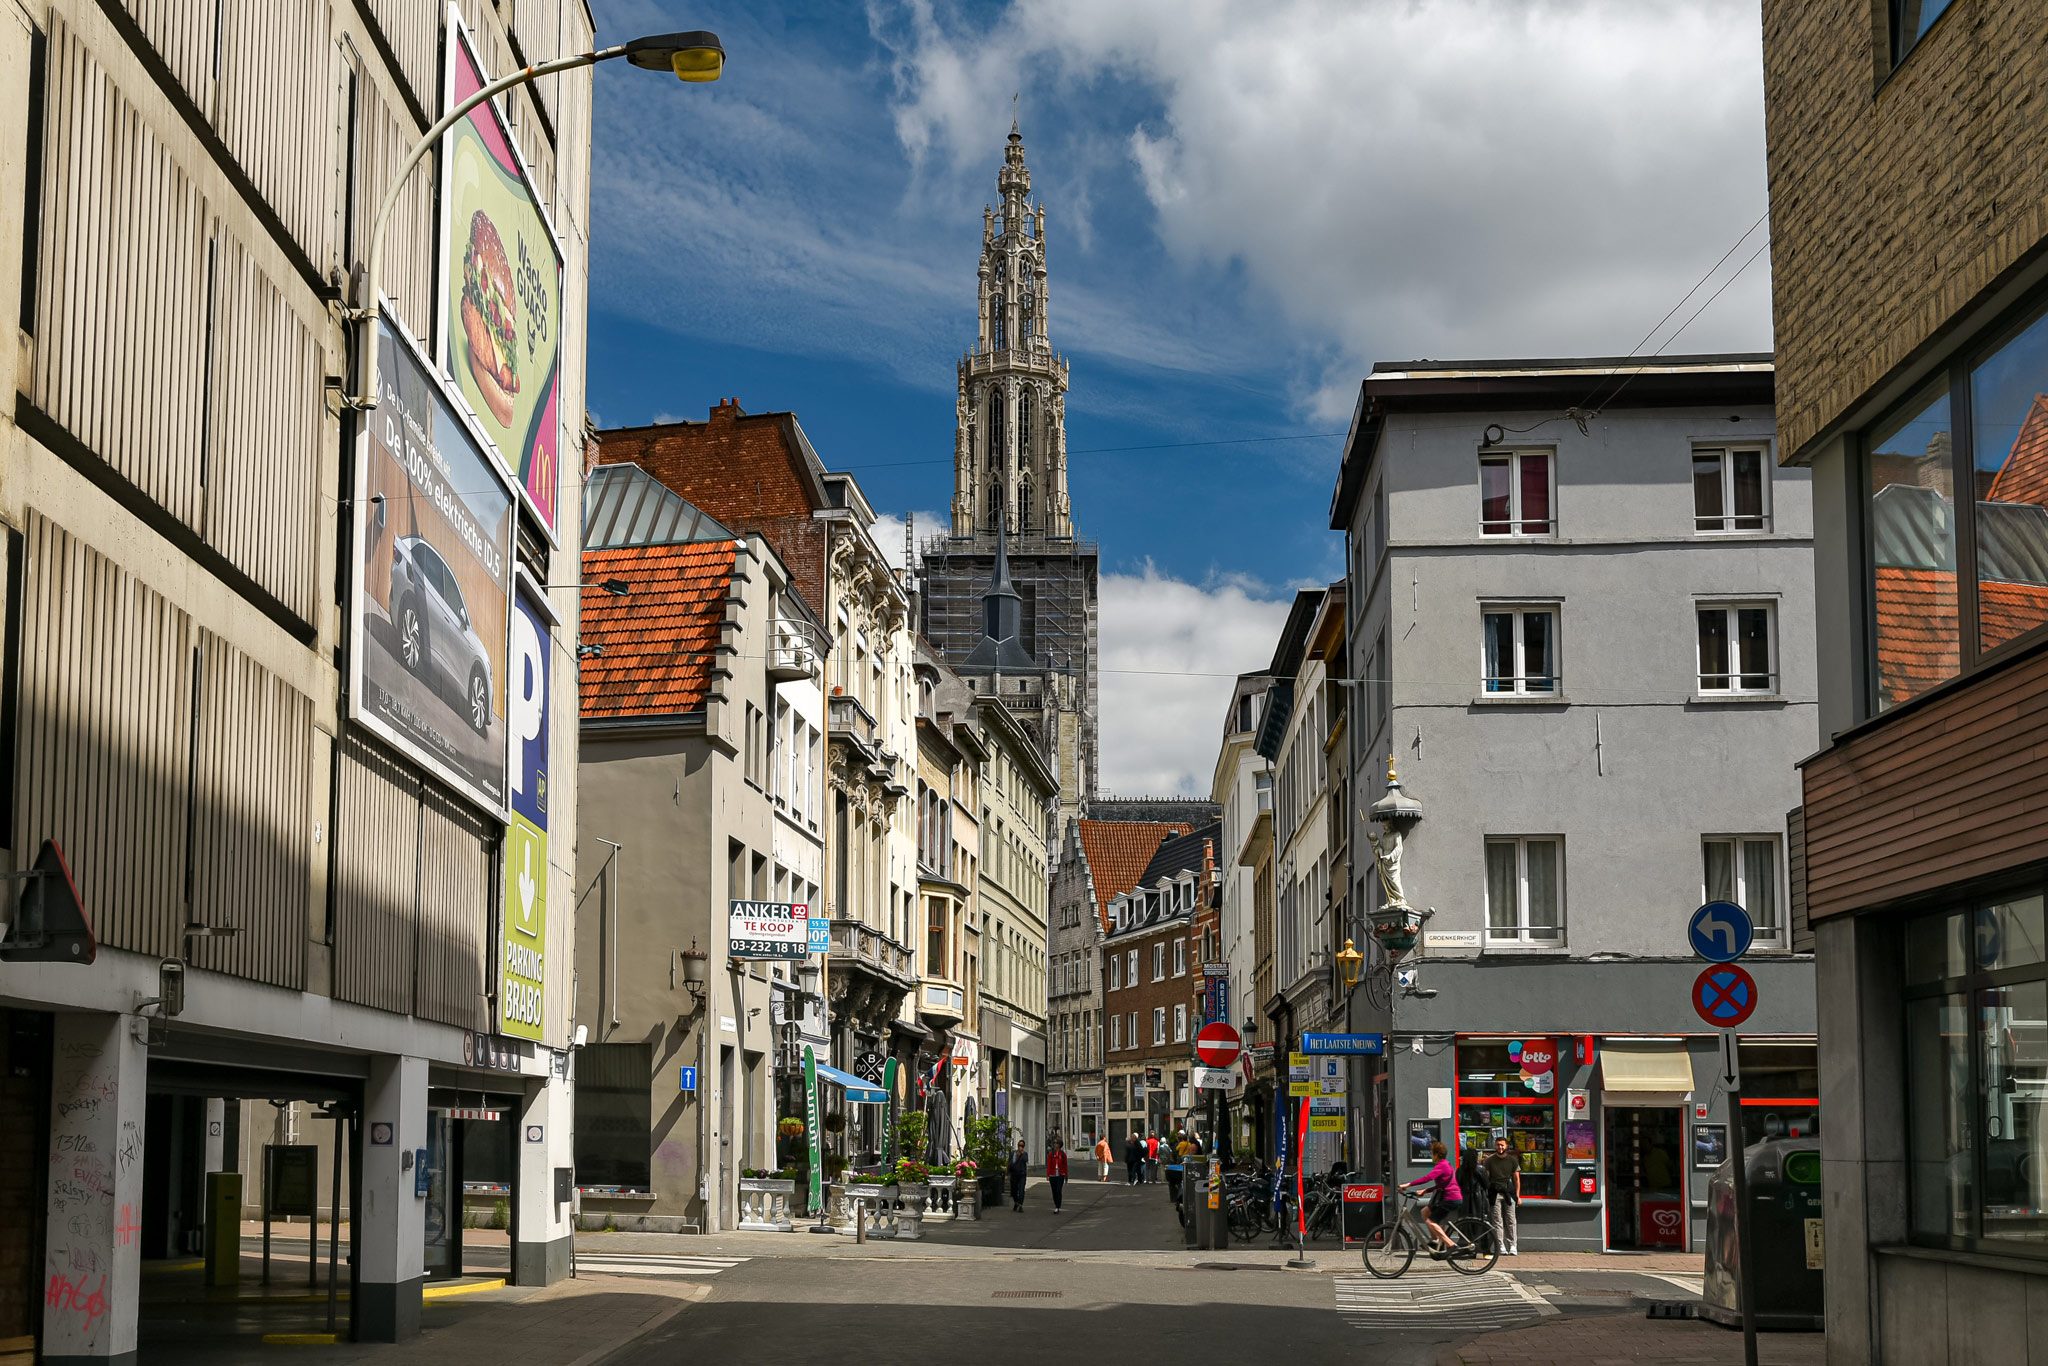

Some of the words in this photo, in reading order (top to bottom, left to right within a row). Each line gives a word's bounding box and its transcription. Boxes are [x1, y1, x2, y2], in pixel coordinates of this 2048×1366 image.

[518, 229, 547, 313] Wacko
[517, 267, 547, 342] GUACO
[387, 383, 396, 406] De
[386, 414, 401, 458] De
[403, 440, 433, 497] 100%
[435, 484, 483, 558] elektrische
[484, 538, 500, 578] ID.5
[512, 606, 544, 796] P
[537, 777, 546, 799] AP
[732, 902, 791, 919] ANKER
[794, 905, 806, 920] 18
[744, 921, 757, 931] TE
[760, 922, 794, 933] KOOP
[731, 940, 771, 952] 03-232
[775, 942, 788, 953] 18
[792, 943, 805, 954] 18
[506, 939, 543, 984] PARKING
[505, 978, 542, 1027] BRABO
[1310, 1039, 1323, 1049] HET
[1324, 1038, 1351, 1049] LAATSTE
[1352, 1039, 1377, 1049] NIEUWS
[868, 1054, 876, 1063] B
[1522, 1050, 1552, 1063] Lotto
[1513, 1114, 1541, 1124] OPEN
